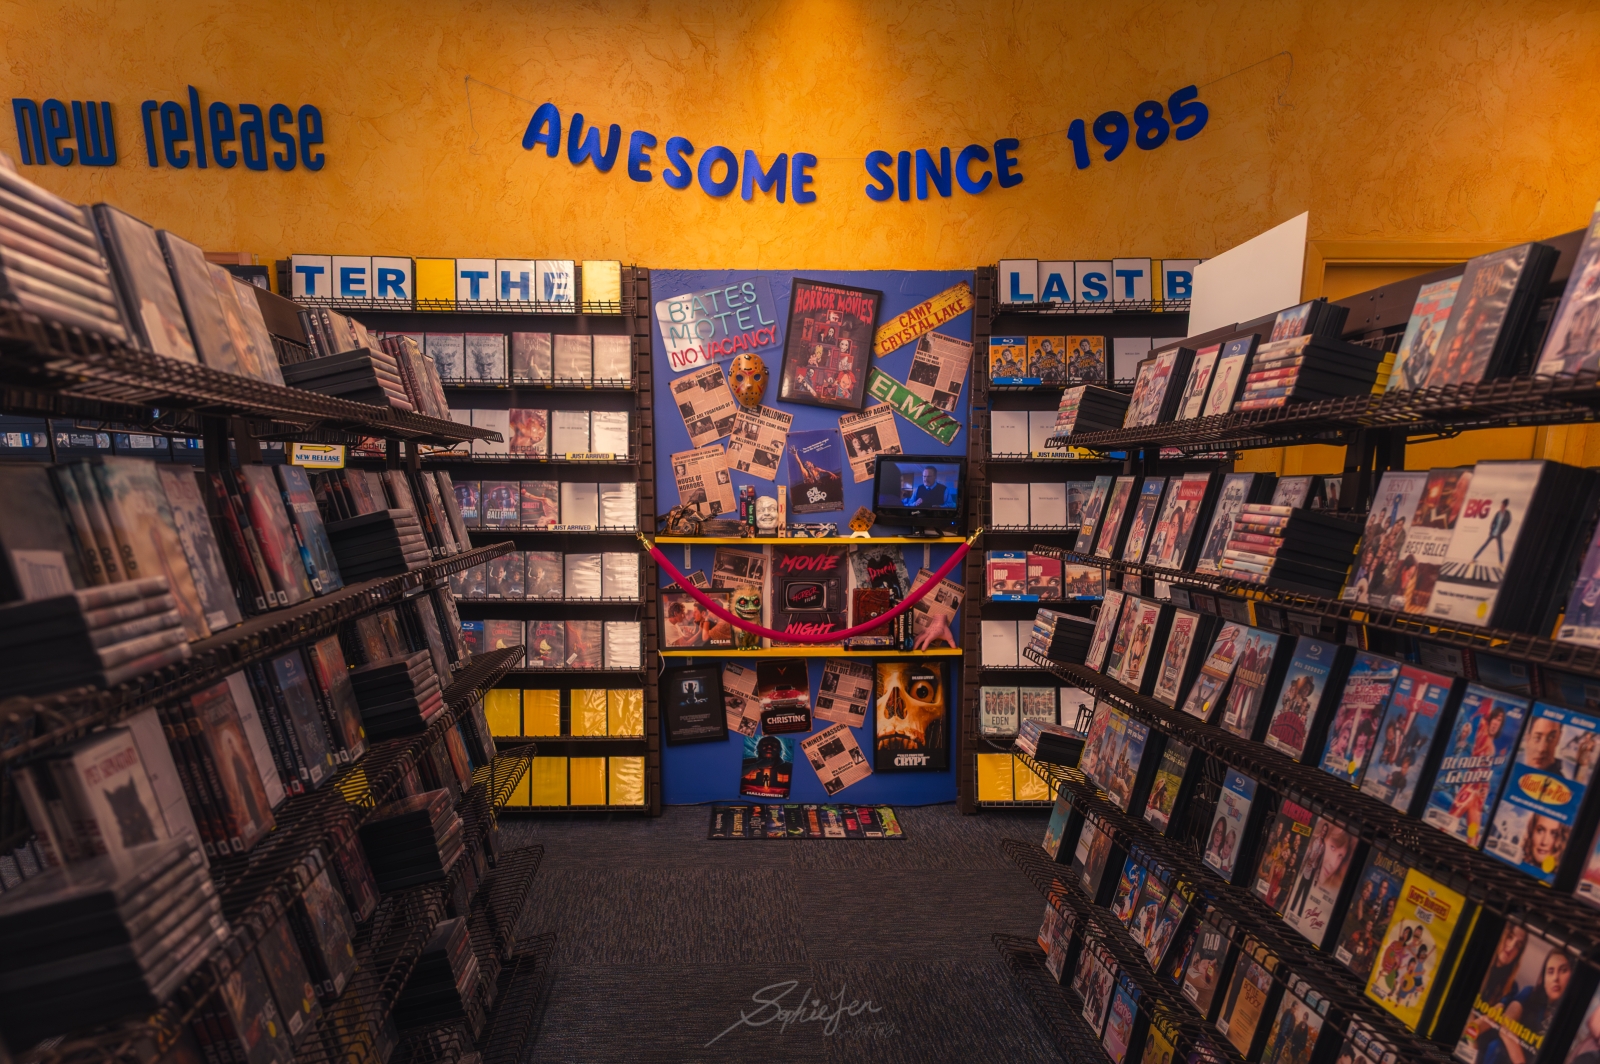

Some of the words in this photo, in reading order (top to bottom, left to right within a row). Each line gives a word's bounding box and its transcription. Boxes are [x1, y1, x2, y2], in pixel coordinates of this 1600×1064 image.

[12, 98, 117, 166] new
[141, 84, 325, 171] release
[522, 102, 817, 204] AWESOME
[865, 138, 1023, 201] SINCE
[1066, 85, 1209, 169] 1985
[461, 270, 569, 300] THE
[815, 286, 846, 295] FREAKING
[1010, 269, 1144, 301] LAST
[668, 282, 757, 322] BATES
[795, 289, 836, 314] HORROR
[837, 296, 874, 325] MOVIES
[899, 302, 933, 328] CAMP
[669, 304, 775, 348] MOTEL
[881, 316, 934, 352] CRYSTAL
[935, 298, 966, 323] LAKE
[671, 347, 698, 368] NO
[699, 325, 777, 360] VACANCY
[1197, 367, 1212, 390] 17
[870, 374, 926, 420] ELM
[685, 416, 696, 424] WHAT
[746, 415, 757, 423] NIGHT
[762, 407, 792, 424] HALLOWEEN
[840, 414, 856, 425] NEVER
[857, 410, 872, 420] SLEEP
[873, 404, 890, 416] AGAIN
[736, 436, 756, 446] HALLOWEEN
[761, 444, 776, 453] COMING
[312, 454, 340, 462] RELEASE
[678, 481, 704, 492] HORRORS
[1387, 479, 1405, 493] BEST
[460, 510, 478, 518] ERINA
[486, 510, 518, 520] BALLERINA
[1464, 499, 1493, 519] BIG
[1404, 541, 1423, 555] BEST
[780, 553, 840, 573] MOVIE
[866, 562, 897, 582] Dracula
[994, 570, 1008, 580] DROP
[1028, 566, 1043, 576] DROP
[804, 595, 816, 603] FILMS
[784, 621, 836, 636] NIGHT
[1262, 673, 1267, 686] 2
[1354, 682, 1392, 696] Excellent
[267, 706, 278, 730] PEOPLE
[275, 729, 285, 747] UNDER
[767, 714, 806, 724] CHRISTINE
[992, 716, 1009, 726] EDEN
[807, 735, 822, 748] MINER
[894, 756, 930, 766] CRYPT
[1441, 756, 1494, 771] BLADES
[1444, 770, 1494, 784] GLORY
[1408, 888, 1424, 905] BOB'S
[1424, 896, 1450, 920] BURGERS
[1416, 908, 1433, 922] MOVIE
[1203, 933, 1221, 950] BAD
[1244, 981, 1260, 996] BOTTLE
[1244, 993, 1262, 1008] SHOCK
[1474, 993, 1544, 1050] booksmart
